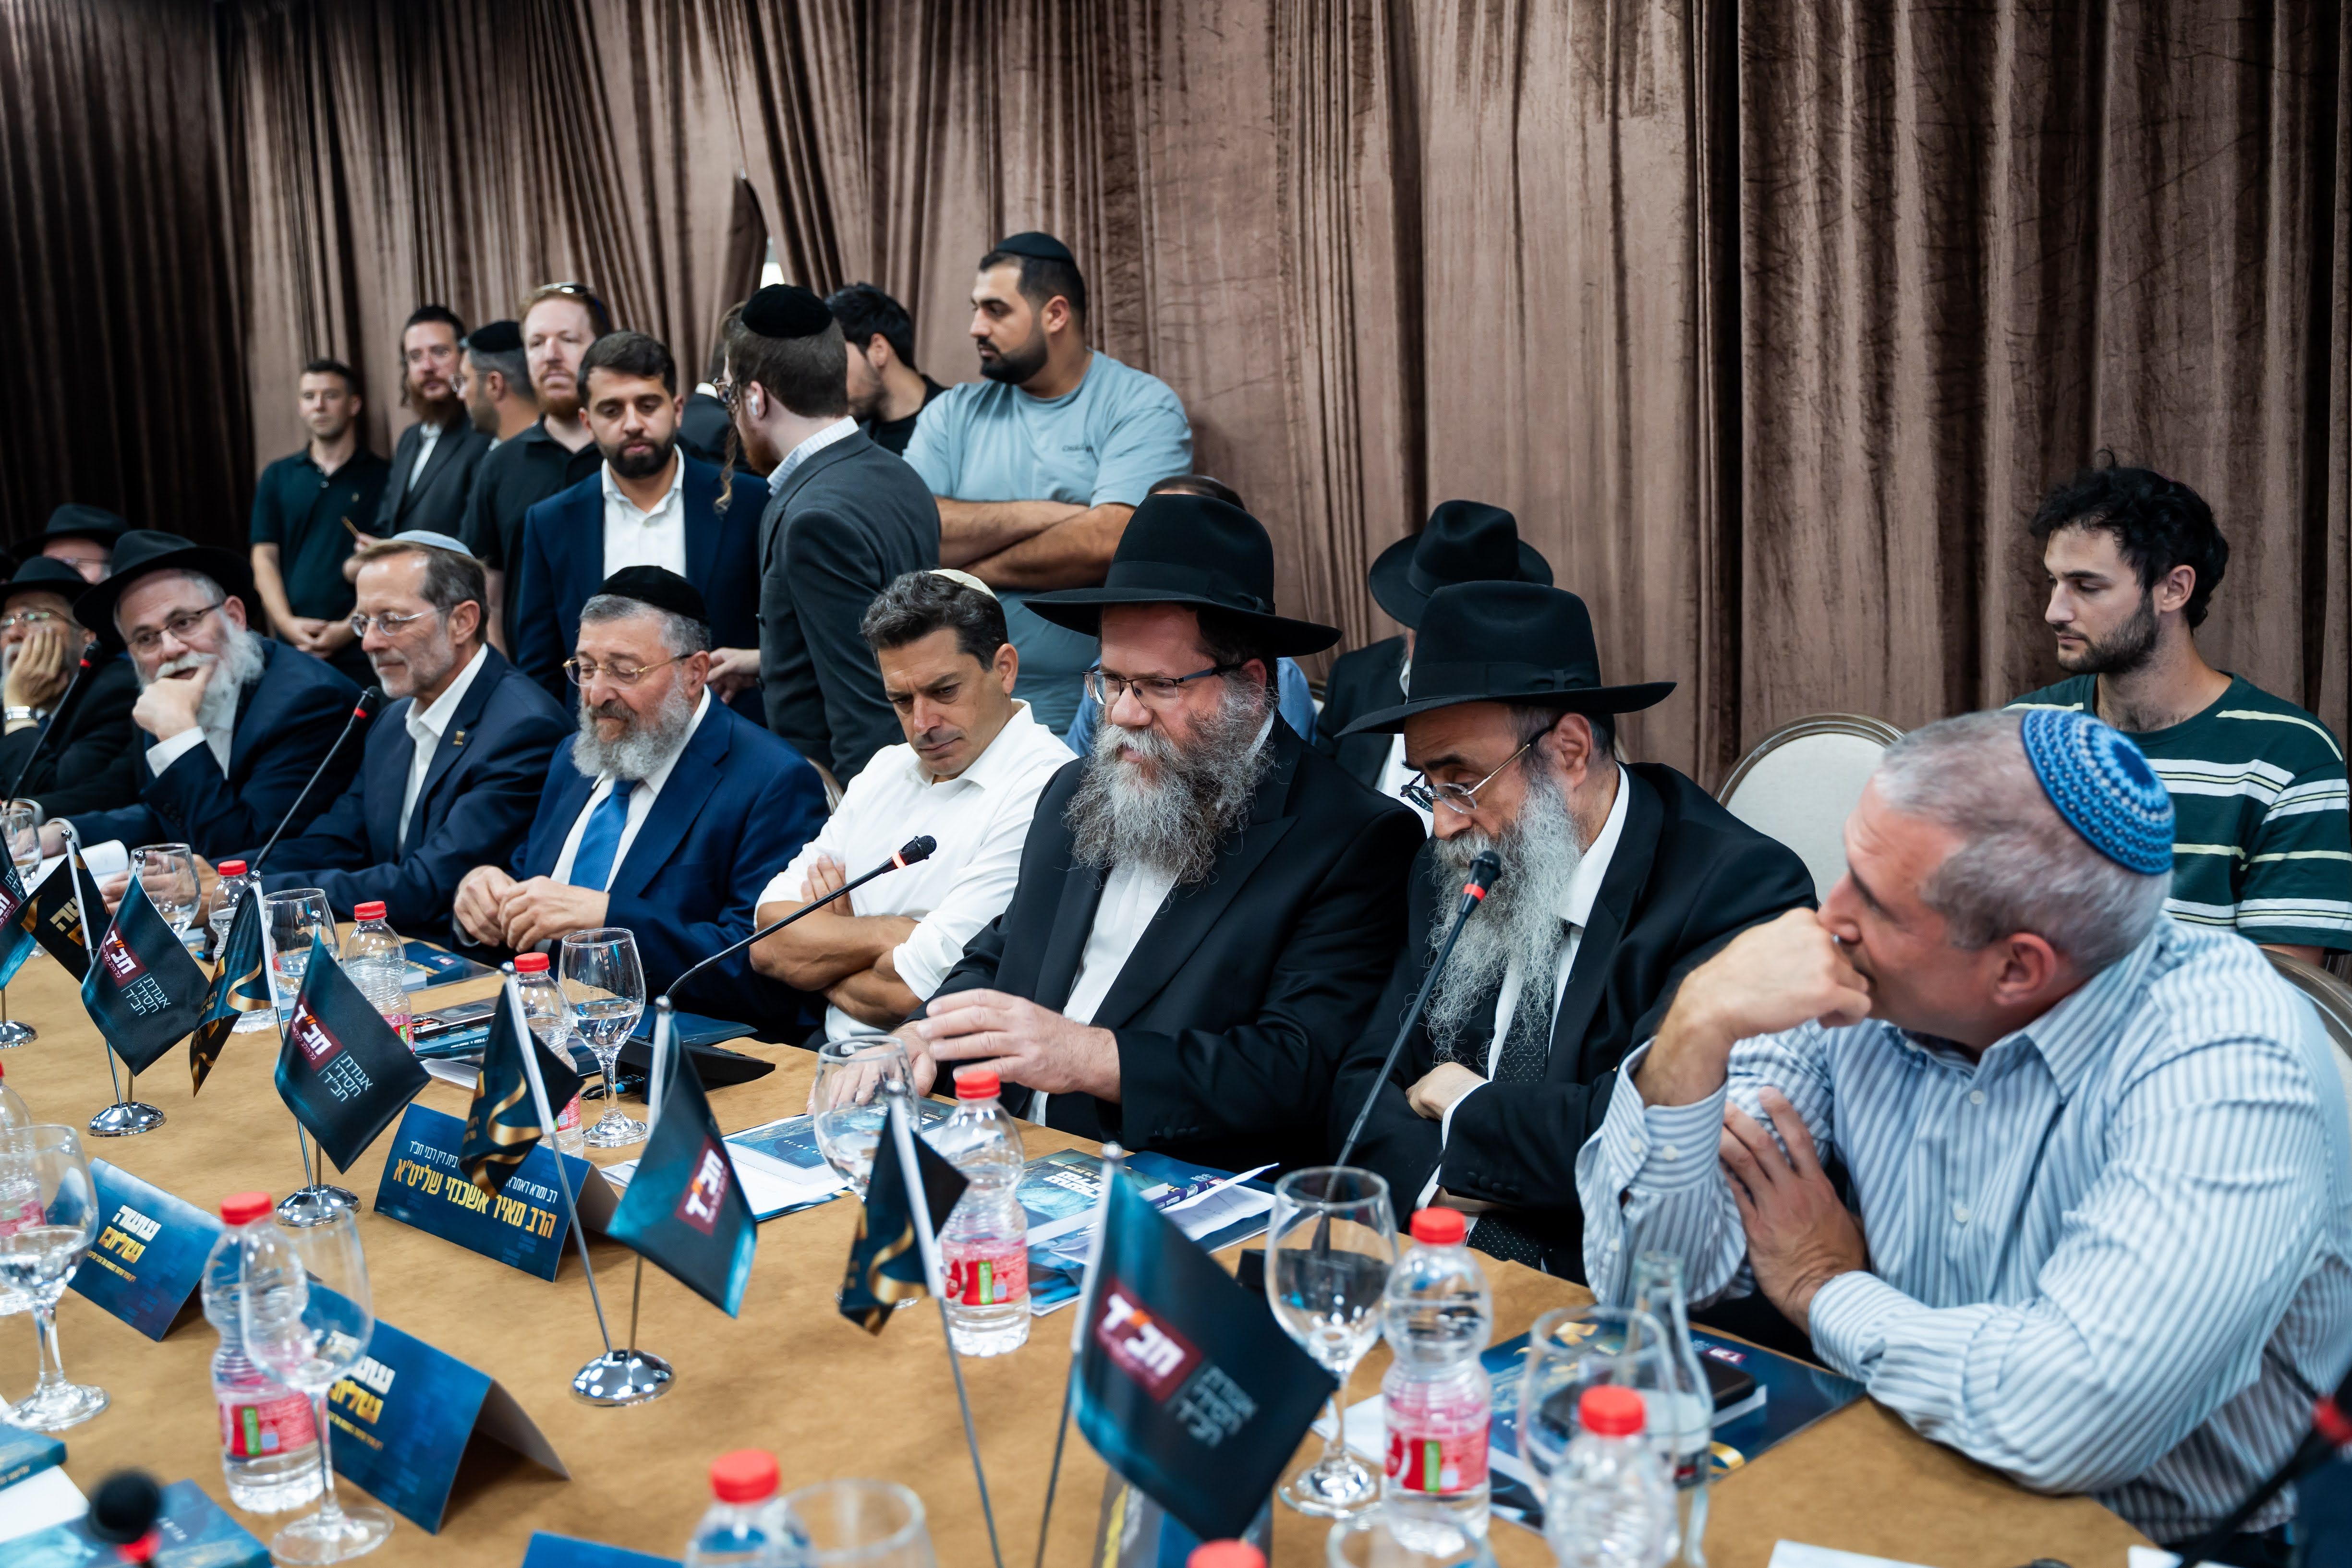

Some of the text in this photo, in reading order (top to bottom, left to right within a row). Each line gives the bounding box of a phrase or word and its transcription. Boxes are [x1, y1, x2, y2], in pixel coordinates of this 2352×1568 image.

[105, 930, 137, 974] חב"ד
[109, 963, 117, 972] הלב
[126, 989, 146, 1016] חב"ד
[137, 983, 159, 1013] חסידי
[143, 977, 171, 1009] אגודת
[294, 1004, 332, 1055] חב"ד
[295, 1031, 303, 1042] לכל
[301, 1041, 311, 1053] הלב
[309, 1051, 316, 1060] כל
[325, 1072, 349, 1102] חב"ד
[336, 1063, 362, 1098] חסידי
[340, 1055, 374, 1091] אגודת
[410, 1141, 459, 1168] בית דין רבני חב"ד
[393, 1158, 558, 1239] הרב מאיר אשכנזי שליט"א
[506, 1176, 558, 1204] רב ומרא דאתרא
[97, 1226, 146, 1263] שלום
